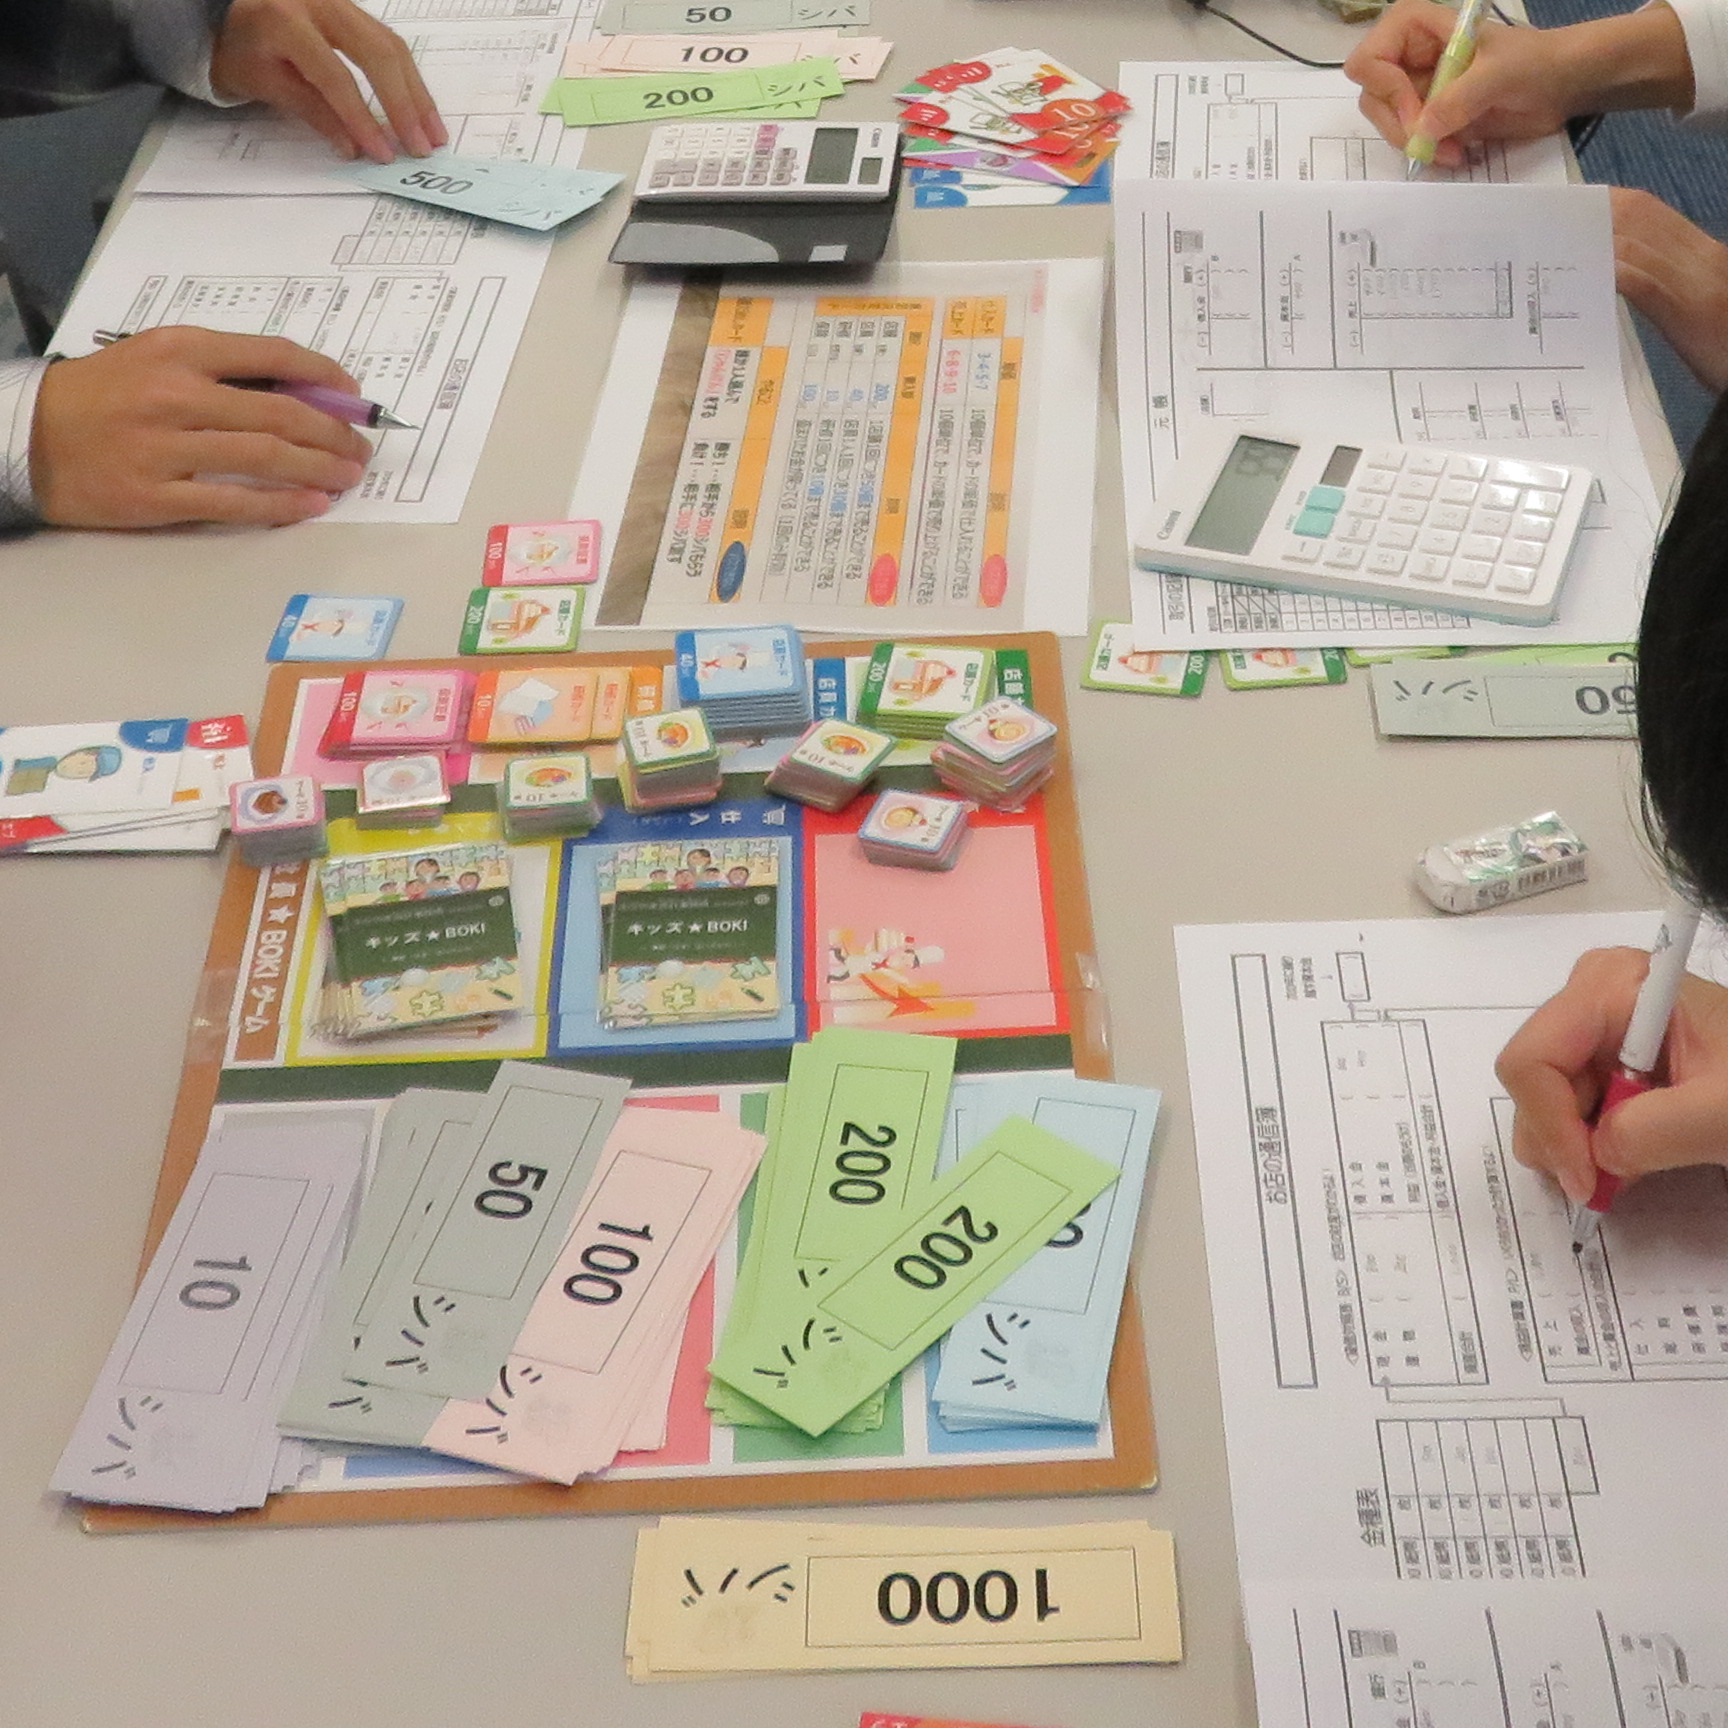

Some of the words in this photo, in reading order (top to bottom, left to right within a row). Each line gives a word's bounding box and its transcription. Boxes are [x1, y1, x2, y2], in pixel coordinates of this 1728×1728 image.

[685, 6, 732, 24] 50
[798, 5, 856, 20] シバ
[680, 46, 749, 63] 100
[643, 87, 713, 110] 200
[767, 75, 826, 97] シバ
[1052, 103, 1097, 123] 10
[400, 170, 473, 195] 500
[489, 542, 503, 561] 100
[341, 690, 357, 712] 100
[829, 1121, 898, 1206] 200
[1255, 1107, 1289, 1204] お店の通信簿
[473, 1159, 549, 1220] 50
[562, 1221, 654, 1308] 100
[893, 1204, 999, 1291] 200
[178, 1255, 253, 1312] 10
[384, 1294, 457, 1375] シバ
[753, 1318, 843, 1390] シバ
[972, 1312, 1031, 1391] シバ
[465, 1365, 544, 1445] シバ
[91, 1396, 164, 1480] シバ
[1355, 1487, 1387, 1549] 金種表
[877, 1567, 1061, 1627] 1000
